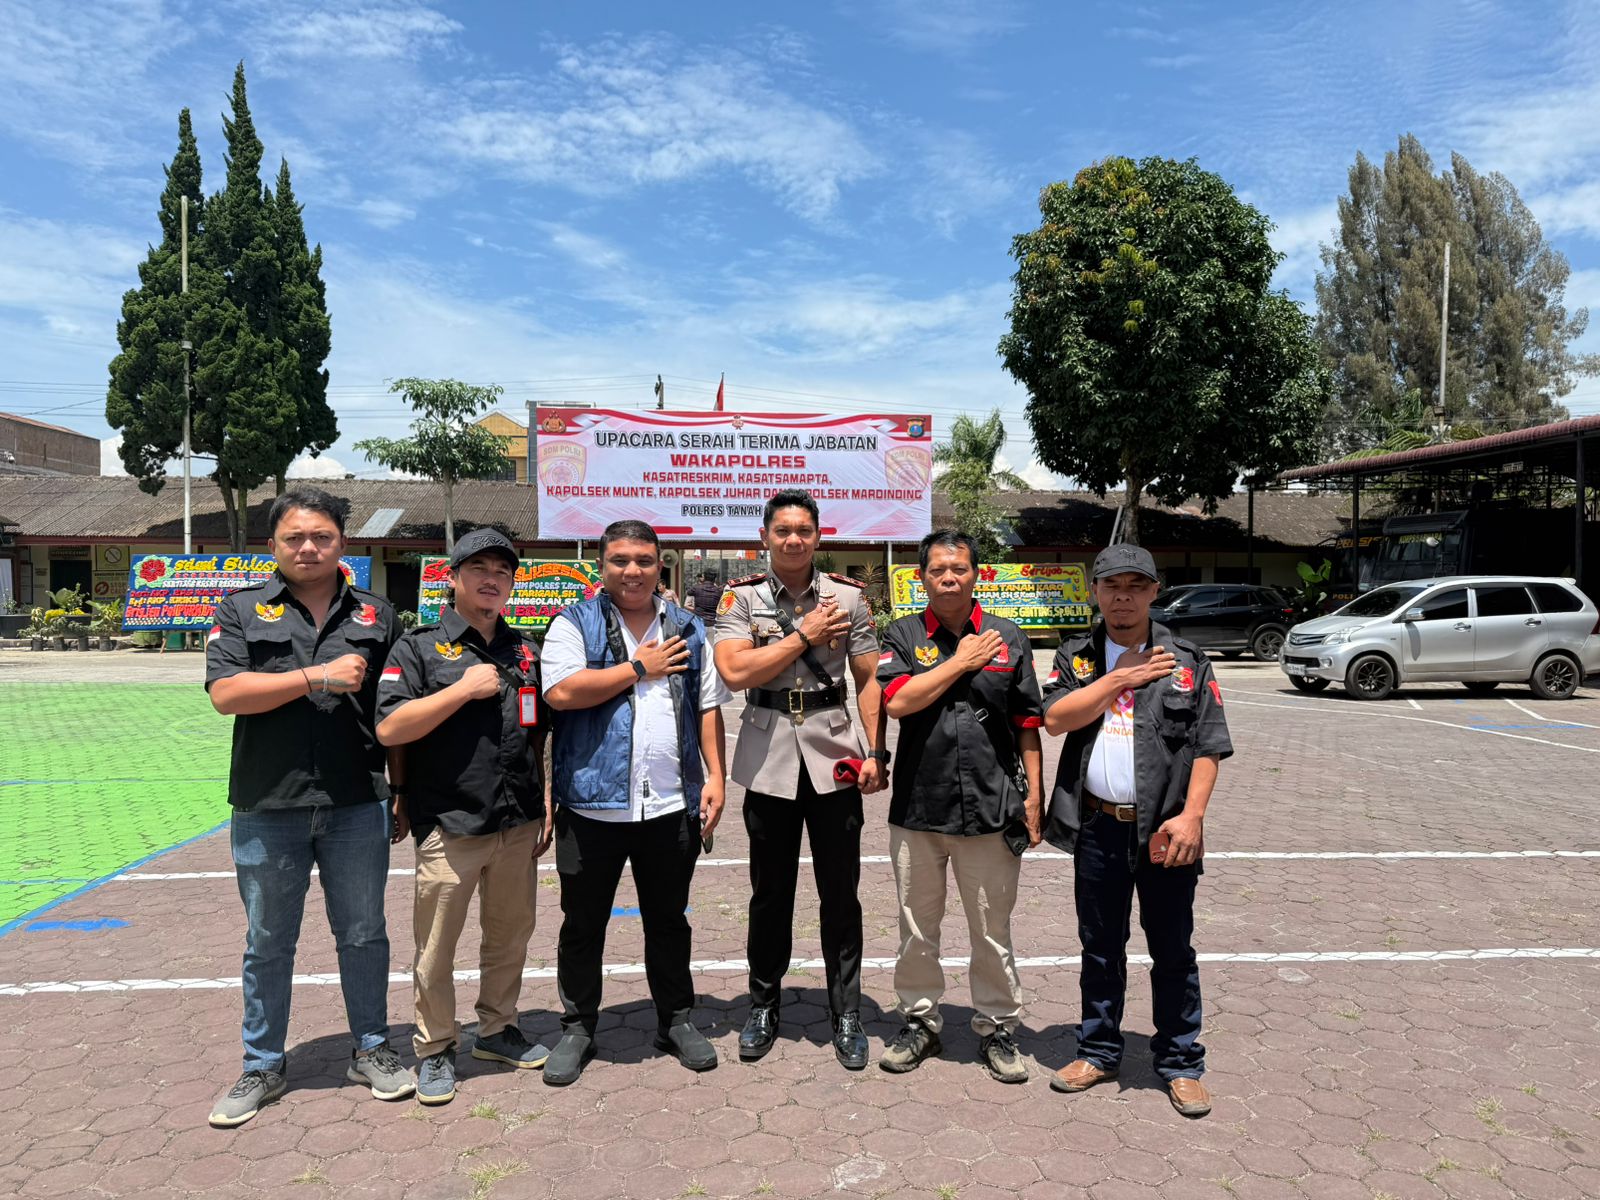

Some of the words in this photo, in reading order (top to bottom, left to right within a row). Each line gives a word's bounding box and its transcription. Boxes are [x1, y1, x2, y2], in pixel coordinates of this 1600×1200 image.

[595, 432, 675, 448] UPACARA
[680, 433, 734, 449] SERAH
[739, 434, 800, 450] TERIMA
[805, 435, 878, 450] JABATAN
[670, 453, 806, 468] WAKAPOLRES
[643, 472, 736, 484] KASATRESKRIM,
[738, 473, 832, 486] KASATSAMAPTA,
[547, 486, 611, 497] KAPOLSEK
[613, 486, 658, 499] MUNTE,
[659, 486, 721, 498] KAPOLSEK
[722, 487, 761, 498] JUHAR
[763, 488, 783, 499] DA
[851, 489, 923, 500] MARDINDING
[682, 504, 724, 516] POLRES
[726, 504, 762, 517] TANAH
[1000, 584, 1035, 592] TANAH
[505, 598, 580, 606] AINGGOLAN,ST
[172, 616, 214, 625] BUPA
[520, 616, 551, 625] SETD
